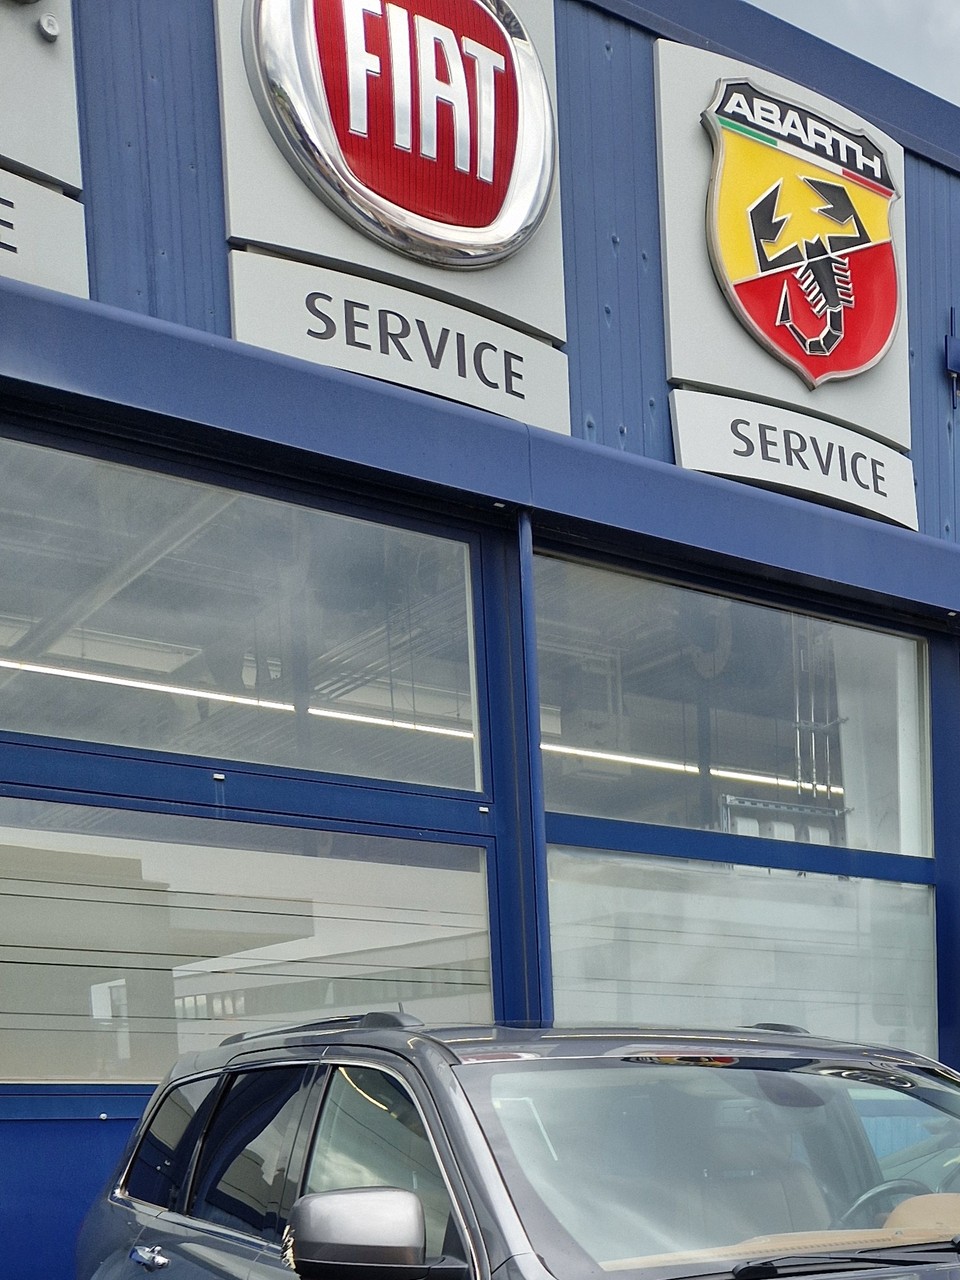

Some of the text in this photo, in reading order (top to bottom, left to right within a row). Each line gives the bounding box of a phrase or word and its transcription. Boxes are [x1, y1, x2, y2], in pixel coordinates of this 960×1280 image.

[343, 0, 505, 184] FIAT
[723, 92, 882, 179] ABARTH
[305, 291, 526, 400] SERVICE
[730, 419, 888, 498] SERVICE
